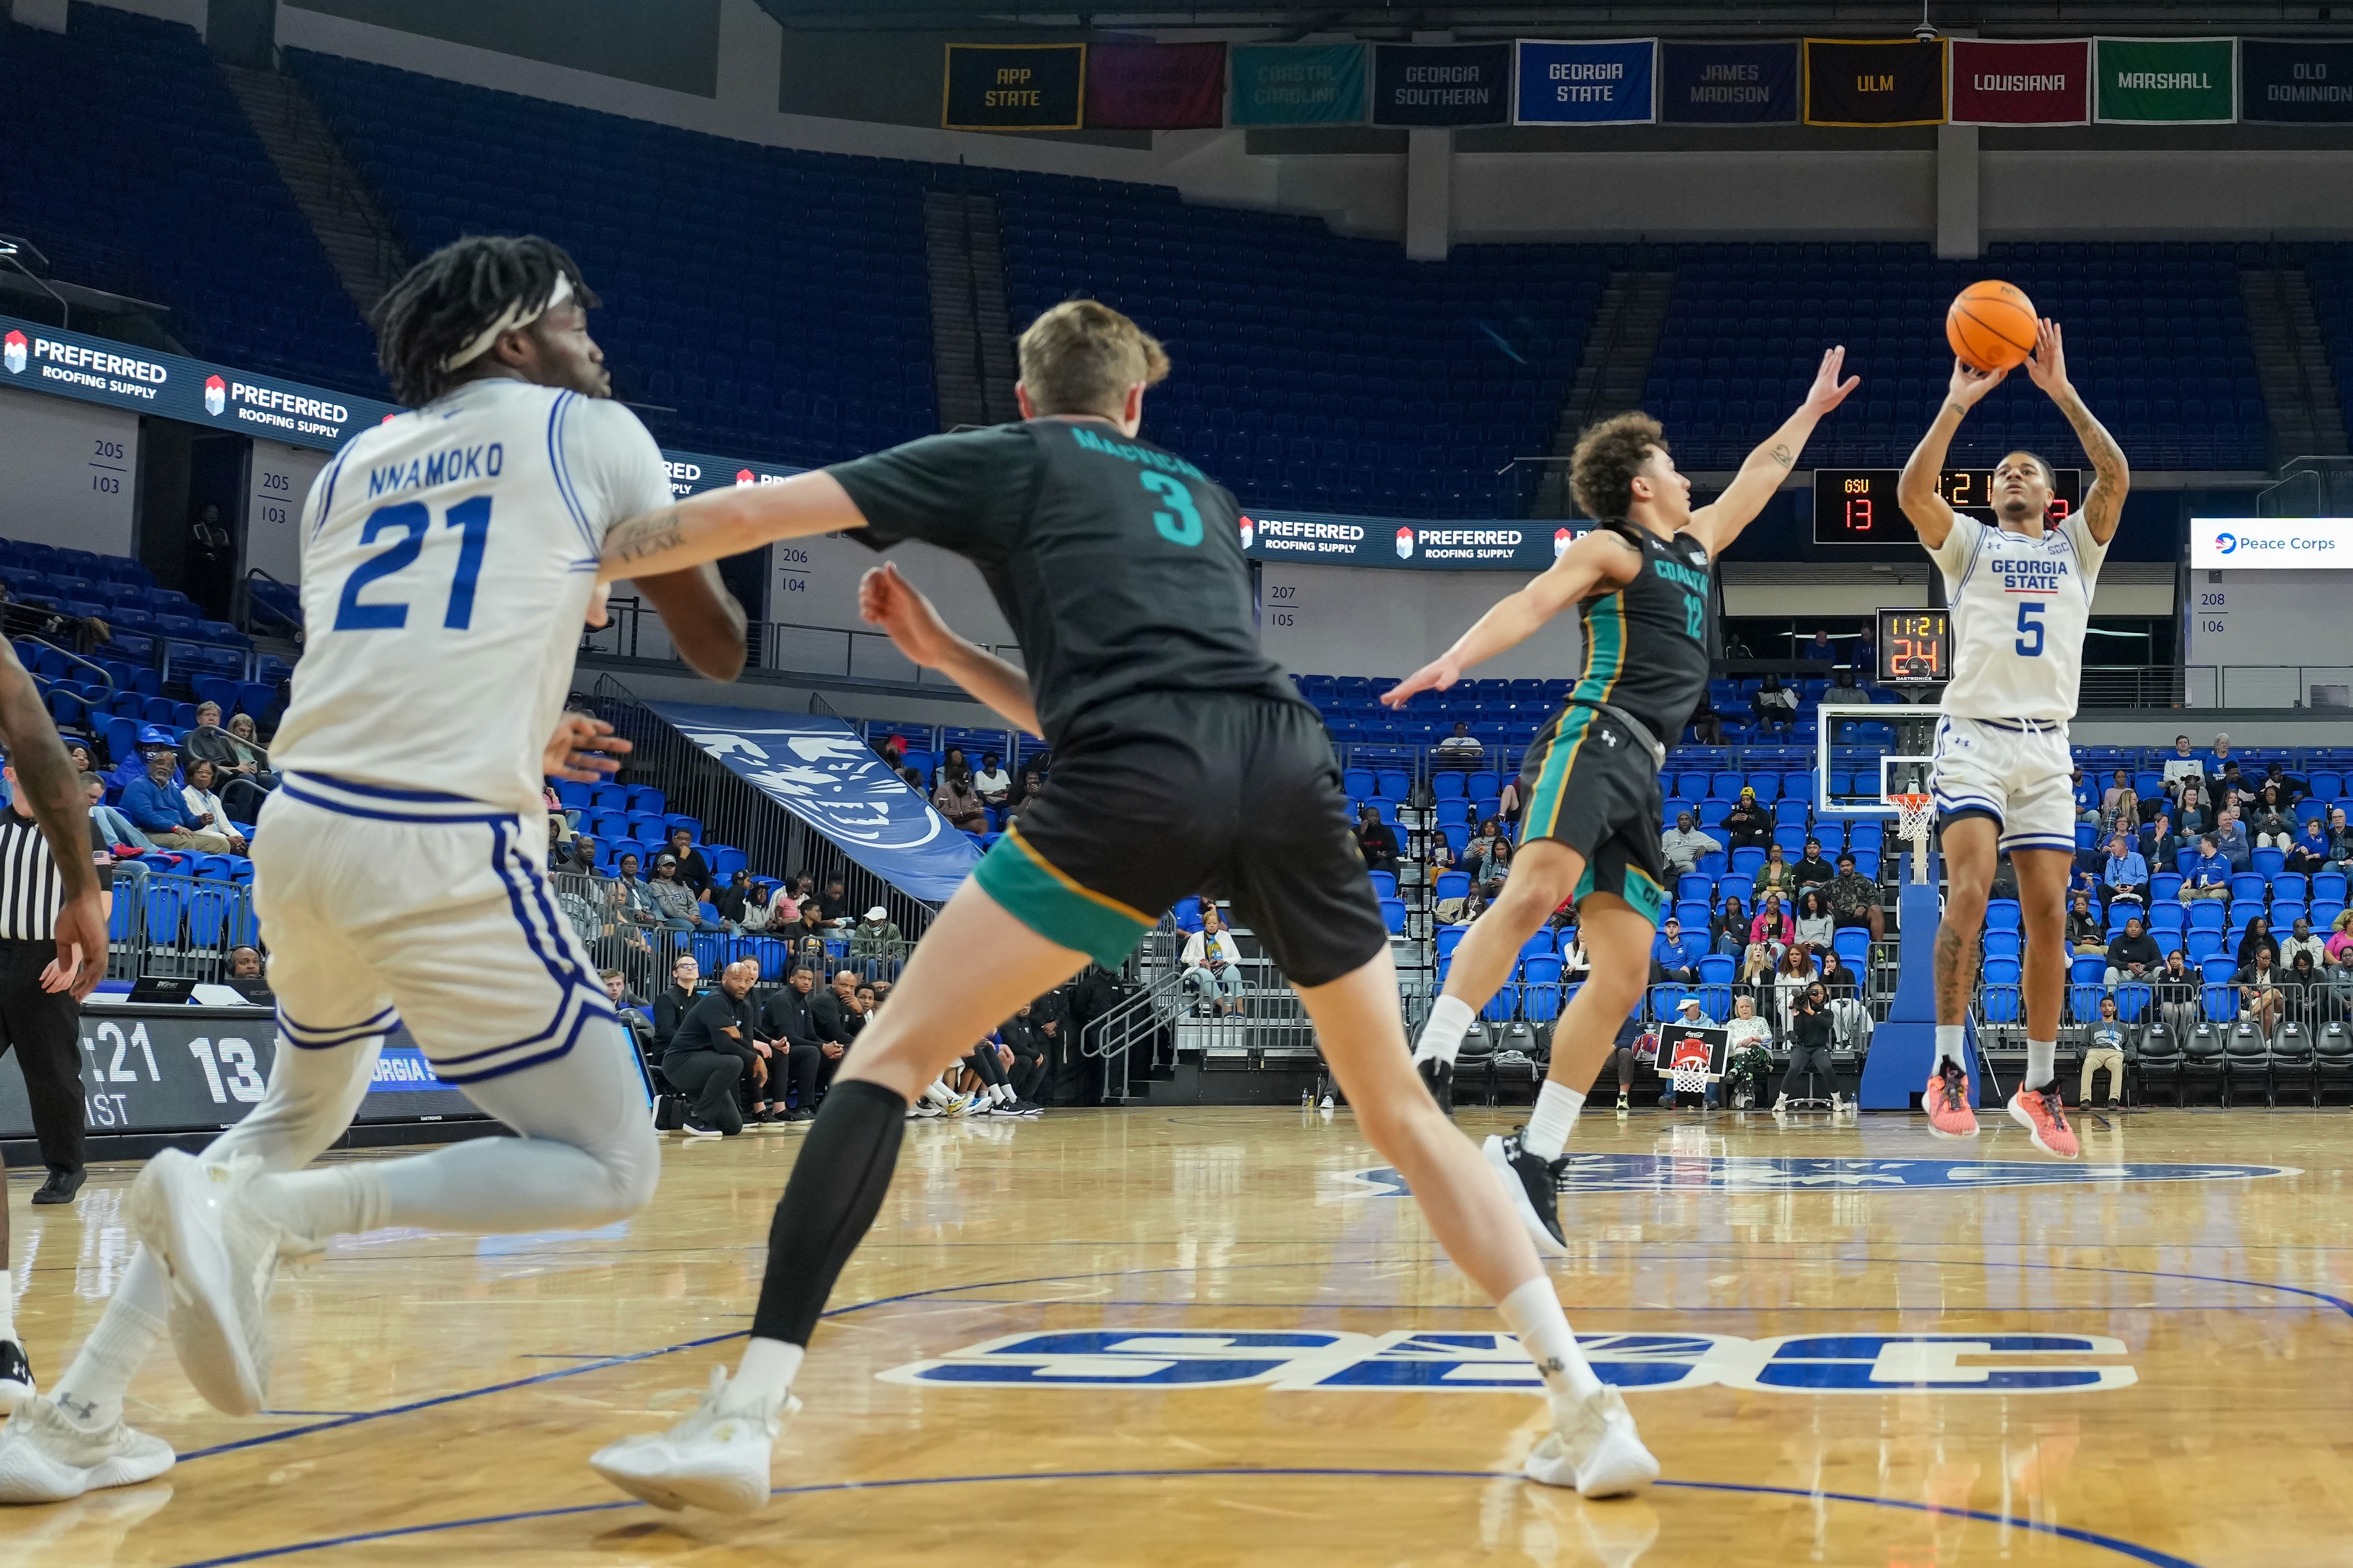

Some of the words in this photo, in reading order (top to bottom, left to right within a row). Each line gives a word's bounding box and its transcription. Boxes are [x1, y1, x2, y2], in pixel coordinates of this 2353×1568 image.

[997, 69, 1031, 84] APP
[1406, 66, 1479, 82] GEORGIA
[1549, 63, 1623, 80] GEORGIA
[1701, 64, 1759, 81] JAMES
[2294, 63, 2326, 79] OLD
[1857, 75, 1893, 92] ULM
[1974, 74, 2065, 91] LOUISIANA
[2118, 72, 2212, 89] MARSHALL
[986, 90, 1041, 107] STATE
[1395, 88, 1489, 105] SOUTHERN
[1557, 86, 1613, 101] STATE
[1691, 86, 1769, 103] MADISON
[2268, 84, 2353, 102] DOMINION
[35, 338, 167, 383] PREFERRED
[43, 365, 106, 389] ROOFING
[109, 380, 157, 399] SUPPLY
[231, 382, 348, 423] PREFERRED
[239, 407, 294, 429] ROOFING
[298, 420, 339, 438] SUPPLY
[94, 440, 123, 459] 205
[369, 442, 503, 499] NNAMOKO
[93, 475, 119, 494] 103
[263, 472, 289, 491] 205
[1845, 479, 1869, 493] GSU
[263, 506, 285, 523] 103
[1140, 469, 1204, 547] 3
[1846, 499, 1872, 530] 13
[1258, 520, 1364, 541] PREFERRED
[1419, 530, 1522, 545] PREFERRED
[1266, 540, 1315, 551] ROOFING
[1318, 542, 1357, 554] SUPPLY
[2241, 538, 2285, 549] Peace
[2290, 538, 2335, 551] Corps
[783, 548, 807, 563] 206
[1426, 549, 1474, 558] ROOFING
[1477, 549, 1515, 559] SUPPLY
[333, 496, 493, 631] 21
[1992, 559, 2068, 575] GEORGIA
[783, 578, 805, 592] 104
[2005, 575, 2058, 589] STATE
[1272, 586, 1295, 599] 207
[2201, 594, 2225, 605] 208
[1272, 614, 1294, 626] 105
[1683, 593, 1703, 640] 12
[1893, 617, 1943, 636] 11:21
[2016, 602, 2045, 656] 5
[2203, 621, 2224, 632] 106
[1891, 639, 1937, 675] 24
[188, 1037, 265, 1103] 13
